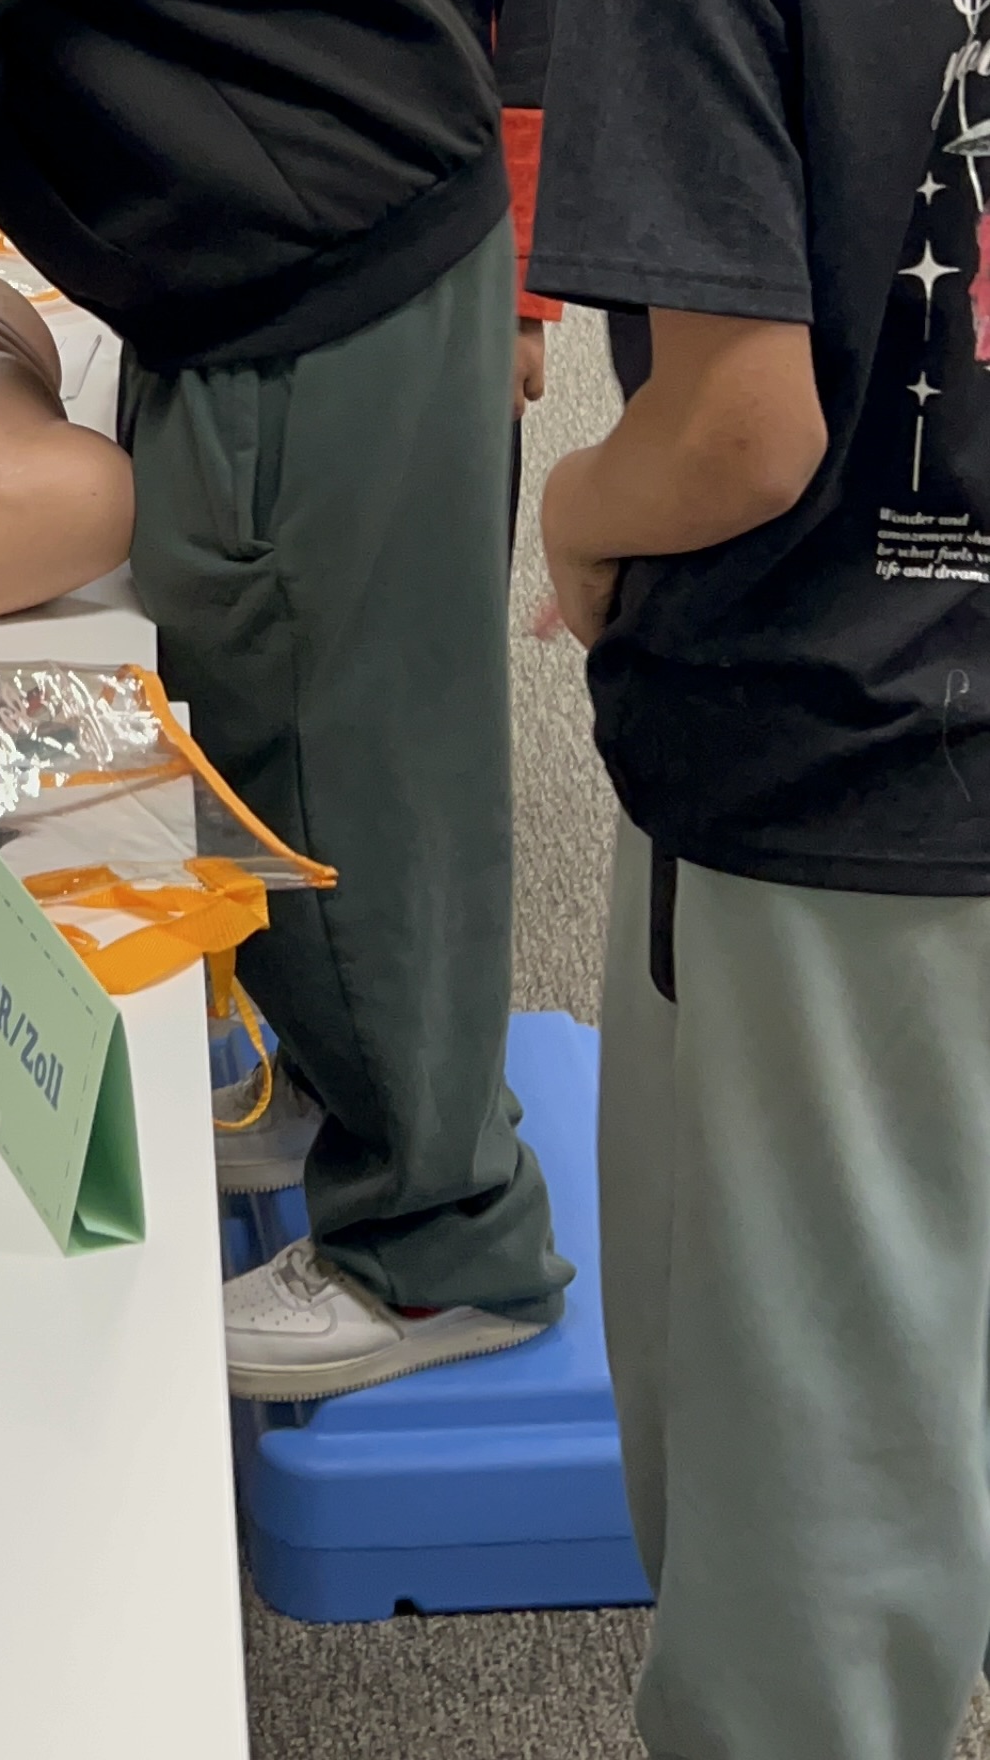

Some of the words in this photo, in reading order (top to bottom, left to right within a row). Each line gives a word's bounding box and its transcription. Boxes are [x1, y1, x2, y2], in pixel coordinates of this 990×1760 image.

[879, 507, 935, 525] Wonder
[938, 513, 971, 527] and
[897, 545, 936, 559] what
[934, 545, 974, 565] fuels
[876, 560, 902, 582] life
[902, 563, 935, 579] and
